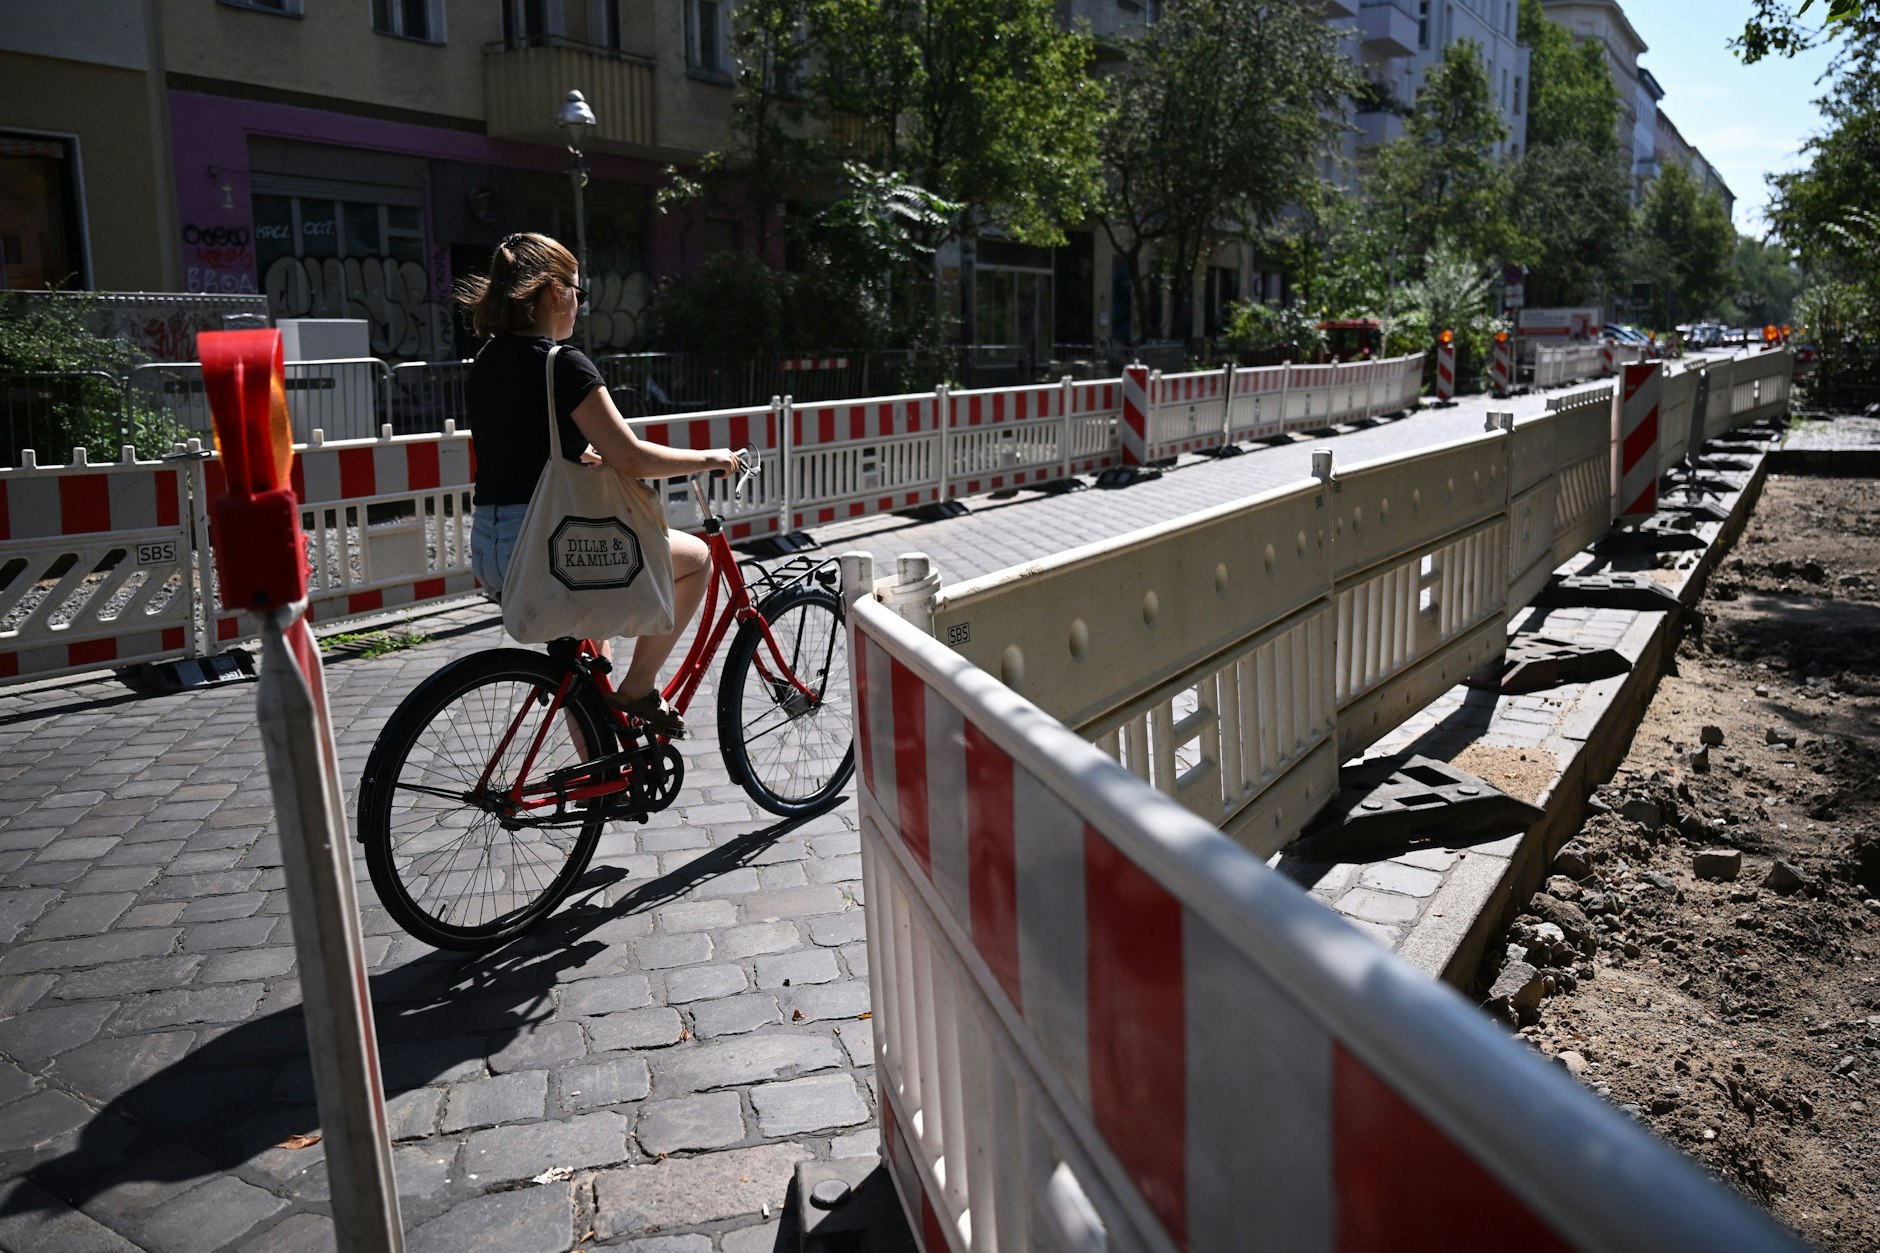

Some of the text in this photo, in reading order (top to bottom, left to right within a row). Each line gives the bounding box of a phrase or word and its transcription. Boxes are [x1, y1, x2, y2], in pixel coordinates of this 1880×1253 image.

[140, 544, 173, 561] SBS
[567, 538, 623, 552] DILLE &
[565, 552, 629, 567] KAMILLE
[950, 625, 968, 643] SBS
